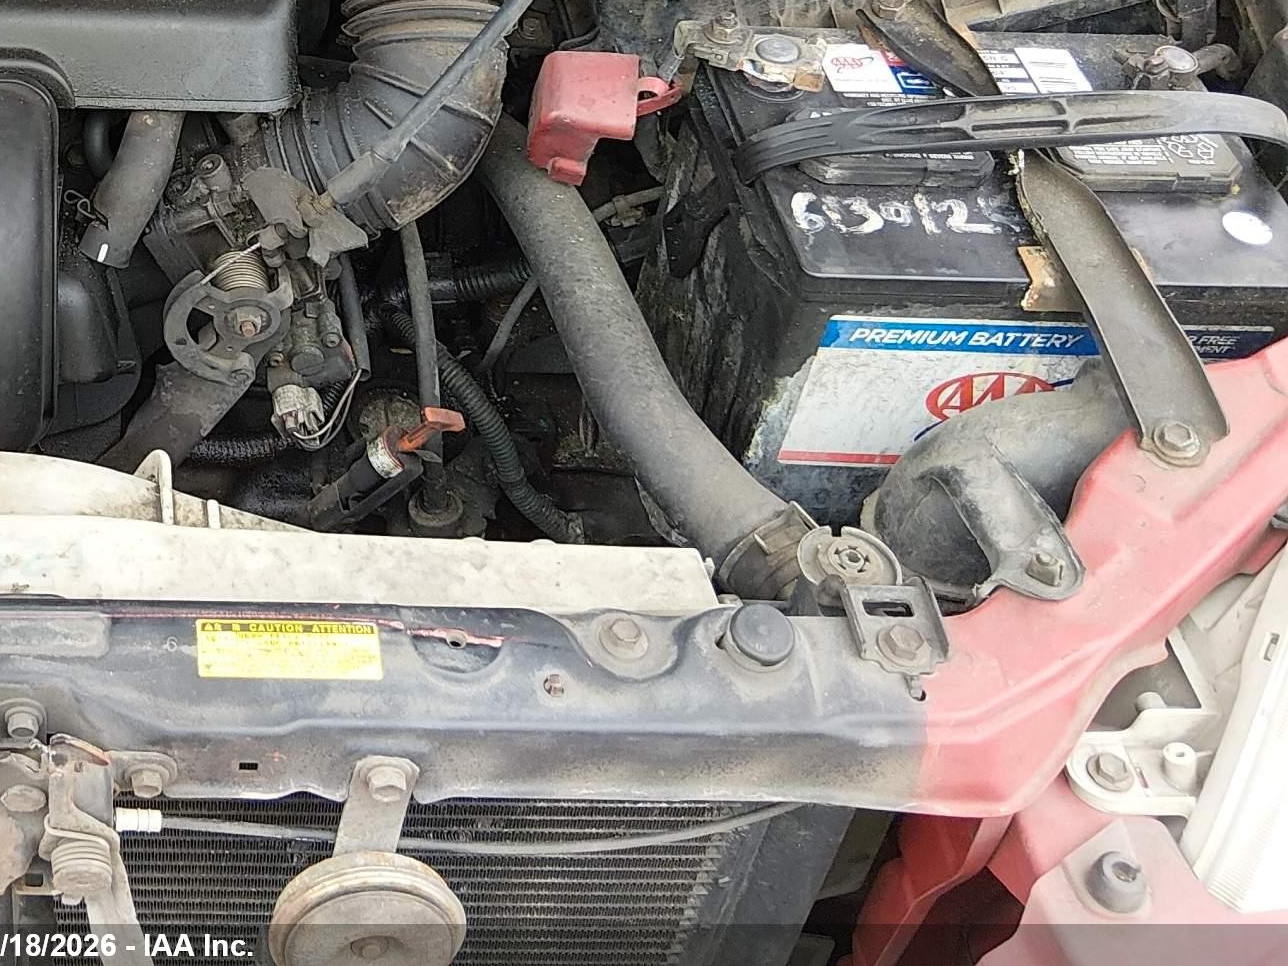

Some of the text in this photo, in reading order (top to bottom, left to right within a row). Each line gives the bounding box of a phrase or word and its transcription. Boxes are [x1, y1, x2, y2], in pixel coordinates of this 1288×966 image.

[849, 327, 1085, 349] PREMIUM BATTERY
[1198, 335, 1239, 345] FREE
[249, 622, 303, 634] CAUTION
[312, 624, 372, 635] ATTENTION
